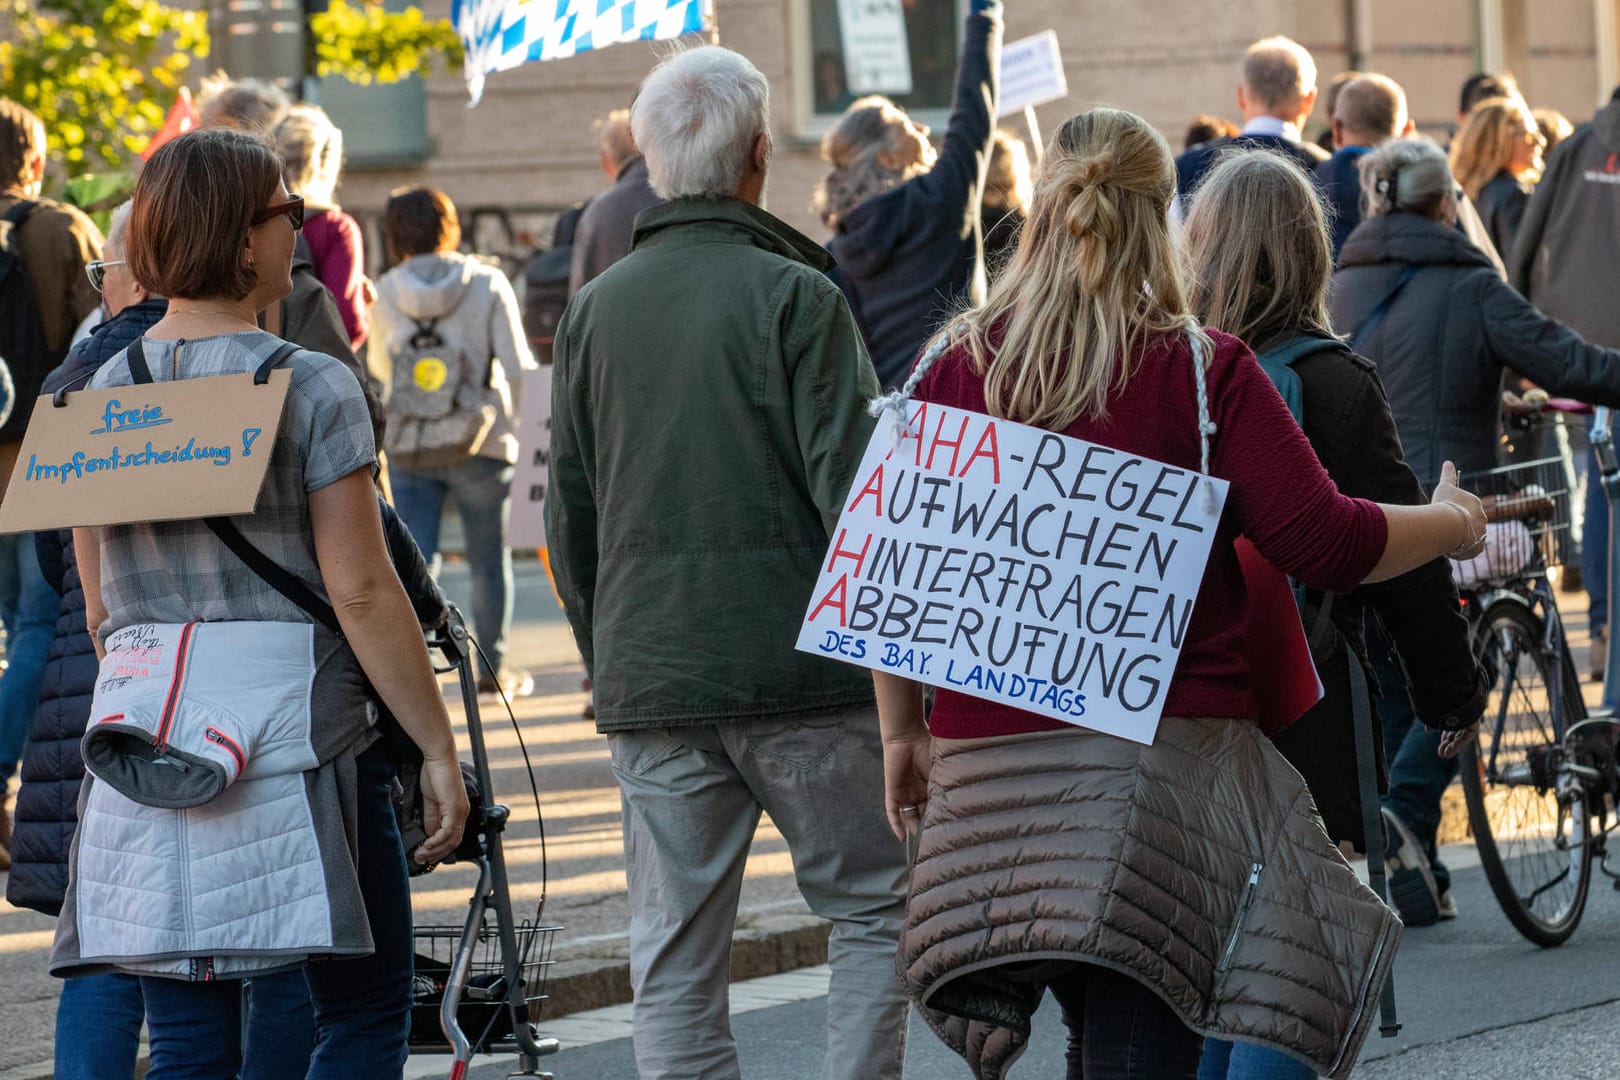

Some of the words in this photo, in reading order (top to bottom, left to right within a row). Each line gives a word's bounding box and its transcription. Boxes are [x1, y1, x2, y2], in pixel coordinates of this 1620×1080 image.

[101, 399, 163, 432] freie
[886, 401, 1204, 533] AHA-REGEL
[848, 462, 1178, 582] AUFWACHEN
[808, 572, 1162, 712] ABBERUFUNG
[827, 528, 1193, 650] HINTERFRAGEN
[819, 630, 867, 658] DES
[880, 641, 932, 676] BAY.
[946, 658, 1086, 716] LANDTAGS
